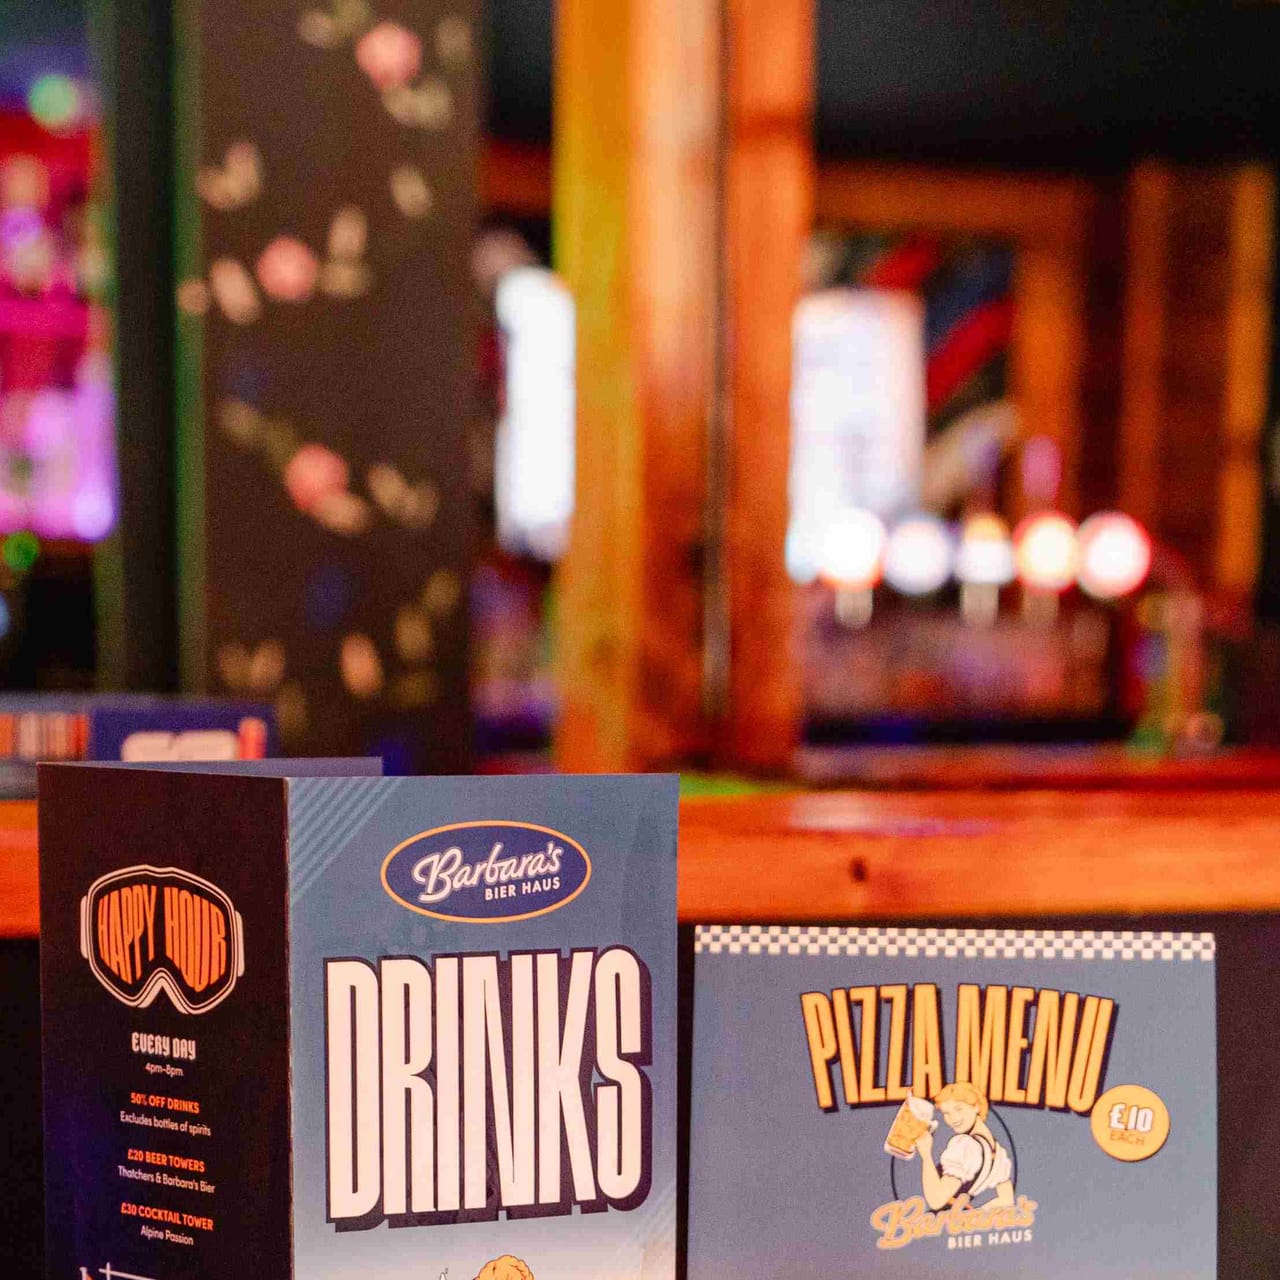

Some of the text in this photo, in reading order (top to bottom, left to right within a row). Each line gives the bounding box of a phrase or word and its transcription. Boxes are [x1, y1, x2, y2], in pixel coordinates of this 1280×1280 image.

[412, 841, 564, 903] Barbara's
[485, 877, 561, 901] BIER HAUS
[98, 884, 227, 993] HAPPY HOUR
[131, 1032, 196, 1060] EVERY DAY
[801, 983, 1116, 1115] PIZZA MENU
[145, 1063, 184, 1078] 4pm-8pm
[325, 947, 646, 1222] DRINKS
[130, 1092, 200, 1114] 50% OFF DRINKS
[120, 1111, 211, 1136] Excludes bottles of spirits
[1108, 1103, 1154, 1133] £10
[127, 1148, 205, 1173] £20 BEER TOWERS
[118, 1165, 216, 1193] Thatchers & Barbara's Bier
[120, 1202, 213, 1231] £30 COCKTAIL TOWER
[870, 1193, 1038, 1248] Barbara's
[140, 1225, 194, 1246] Alpine Passion
[947, 1230, 1033, 1249] BIER HAUS
